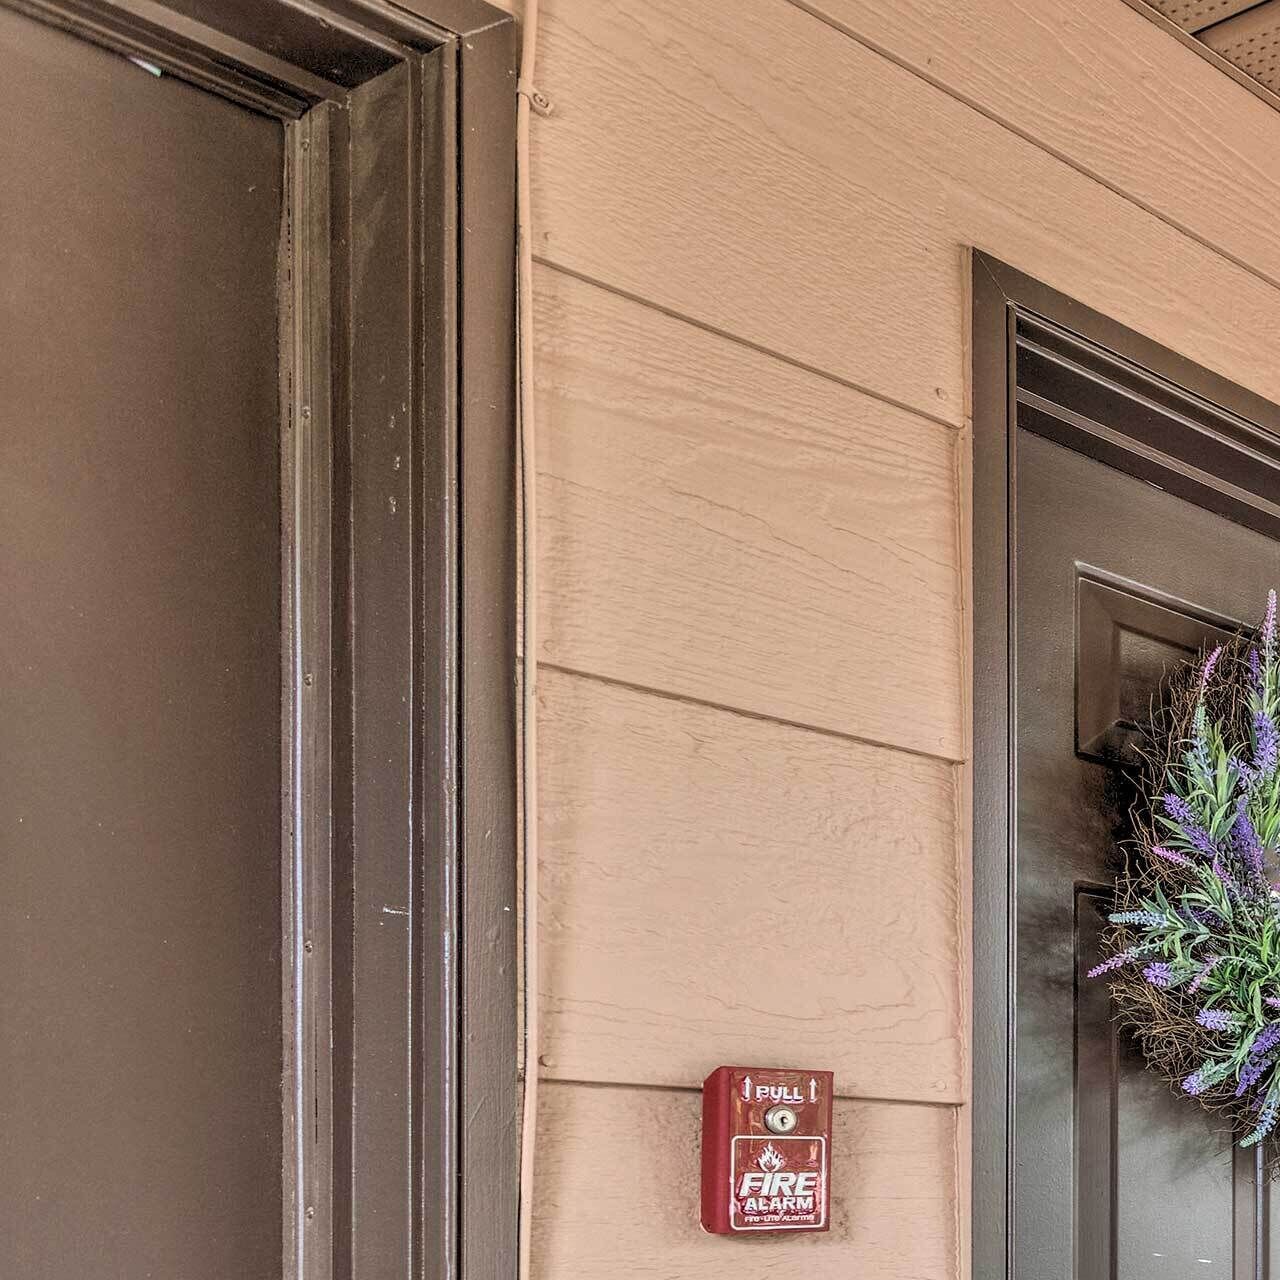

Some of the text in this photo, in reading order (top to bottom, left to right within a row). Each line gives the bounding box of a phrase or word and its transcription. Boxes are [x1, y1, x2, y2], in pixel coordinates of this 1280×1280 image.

[755, 1086, 803, 1100] PULL
[739, 1172, 818, 1196] FIRE
[744, 1196, 814, 1211] ALARM
